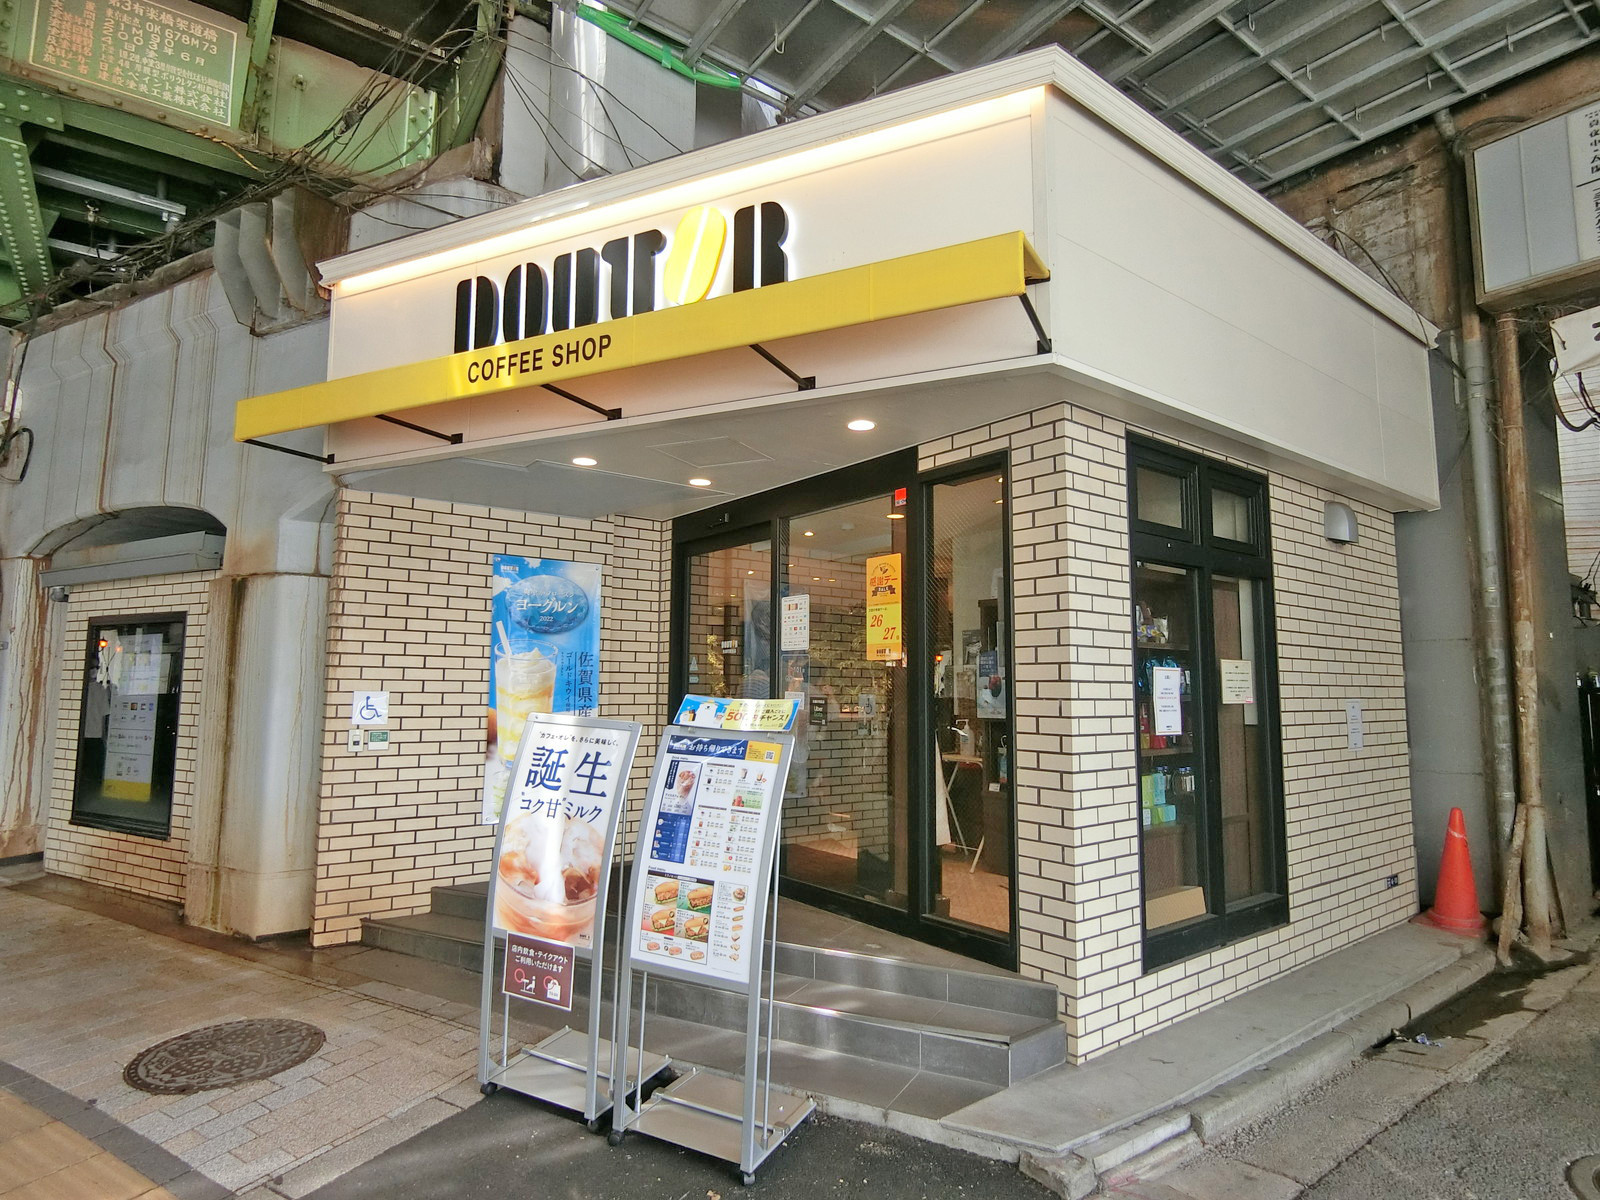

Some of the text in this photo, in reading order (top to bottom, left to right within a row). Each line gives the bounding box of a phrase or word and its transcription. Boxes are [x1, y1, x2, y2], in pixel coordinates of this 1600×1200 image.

[454, 201, 788, 354] DOUTOR
[468, 334, 612, 384] COFFEE SHOP
[516, 597, 579, 613] ヨーグルン
[870, 614, 883, 627] 26
[883, 627, 896, 640] 27
[525, 746, 612, 798] 誕生
[511, 944, 568, 964] 店内飲食・テイクアウト
[515, 955, 564, 973] ご利用いただけます
